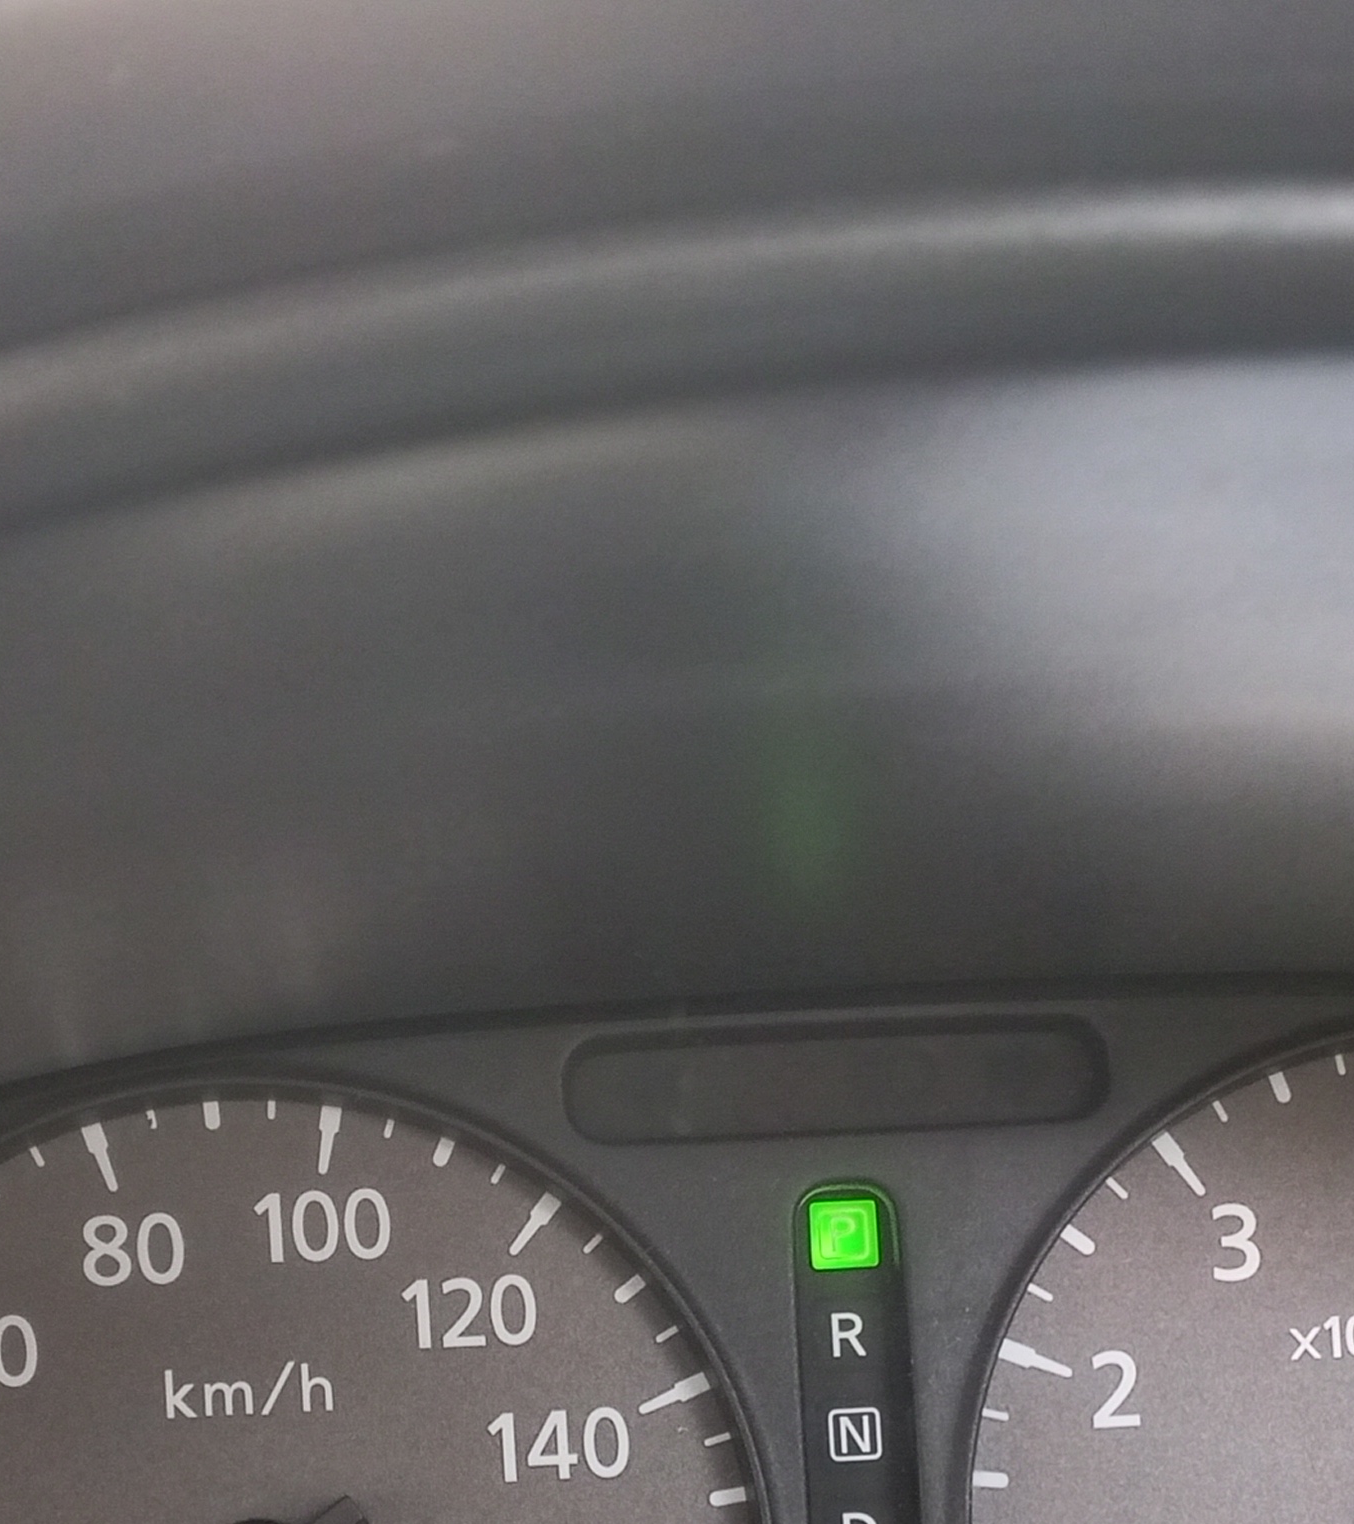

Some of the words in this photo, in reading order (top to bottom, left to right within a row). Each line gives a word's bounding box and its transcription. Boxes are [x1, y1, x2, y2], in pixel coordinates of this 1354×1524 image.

[81, 1212, 186, 1286] 80
[253, 1187, 391, 1263] 100
[831, 1216, 857, 1252] P
[1210, 1203, 1262, 1282] 3
[401, 1273, 537, 1349] 120
[830, 1312, 867, 1357] R
[164, 1360, 334, 1420] km/h
[1090, 1350, 1141, 1429] 2
[487, 1407, 630, 1483] 140
[838, 1414, 871, 1454] N
